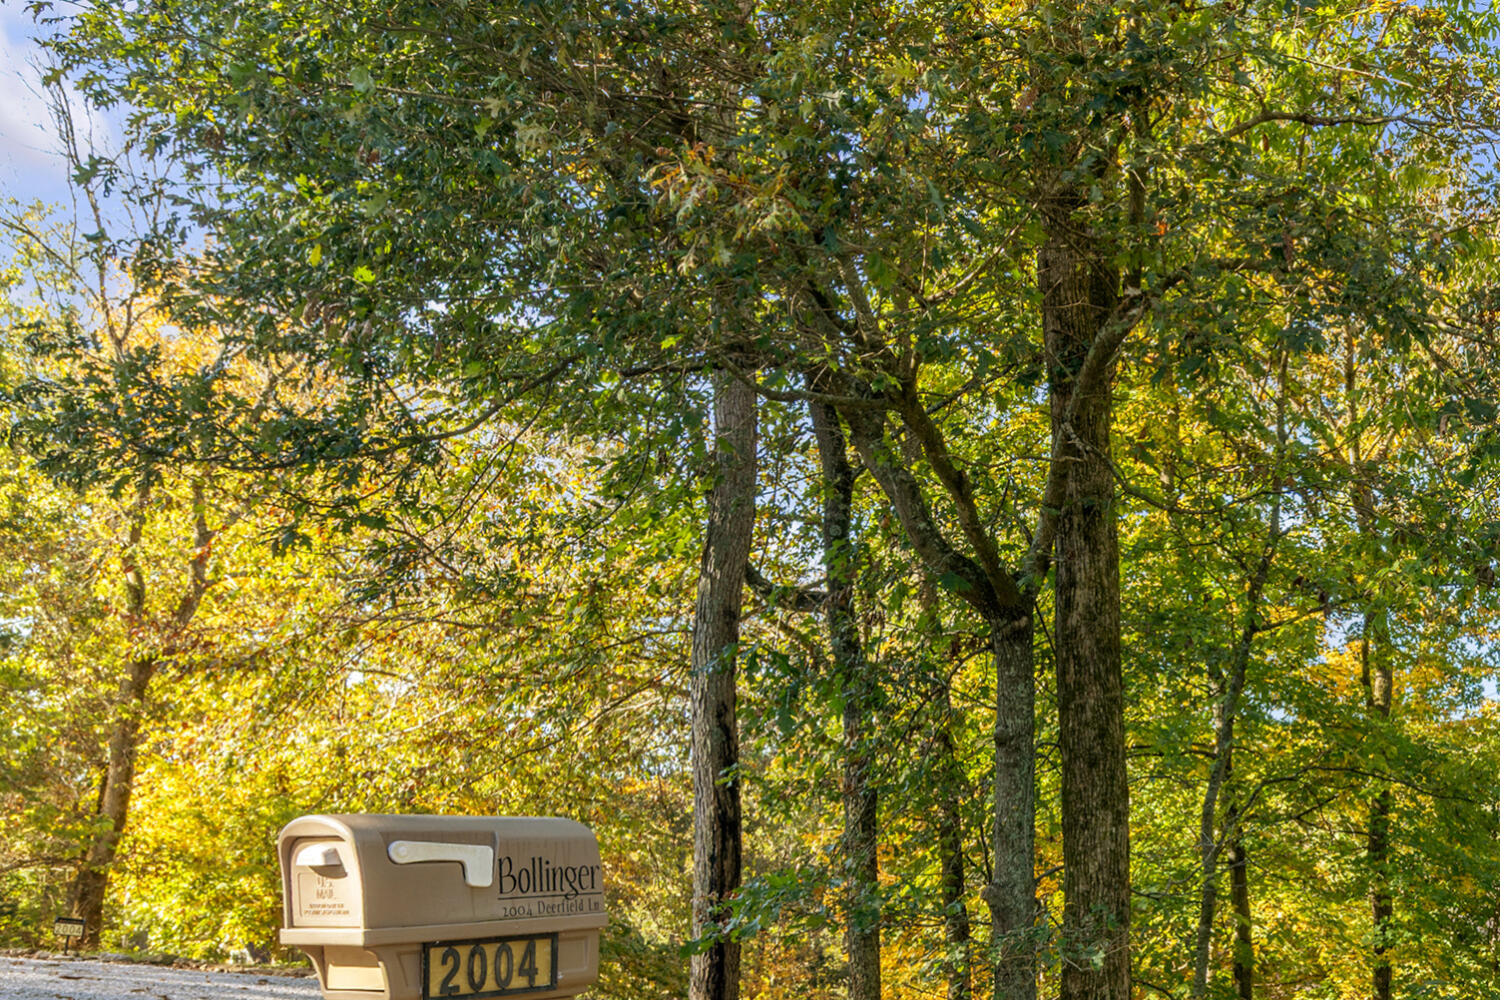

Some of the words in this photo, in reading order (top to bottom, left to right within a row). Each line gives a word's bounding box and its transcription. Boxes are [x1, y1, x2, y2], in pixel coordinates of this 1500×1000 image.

[498, 856, 600, 900] Bollinger
[503, 904, 532, 917] 2004
[537, 898, 584, 914] Deerfield
[588, 898, 600, 911] Ln
[55, 923, 82, 935] 2004
[440, 940, 539, 995] 2004
